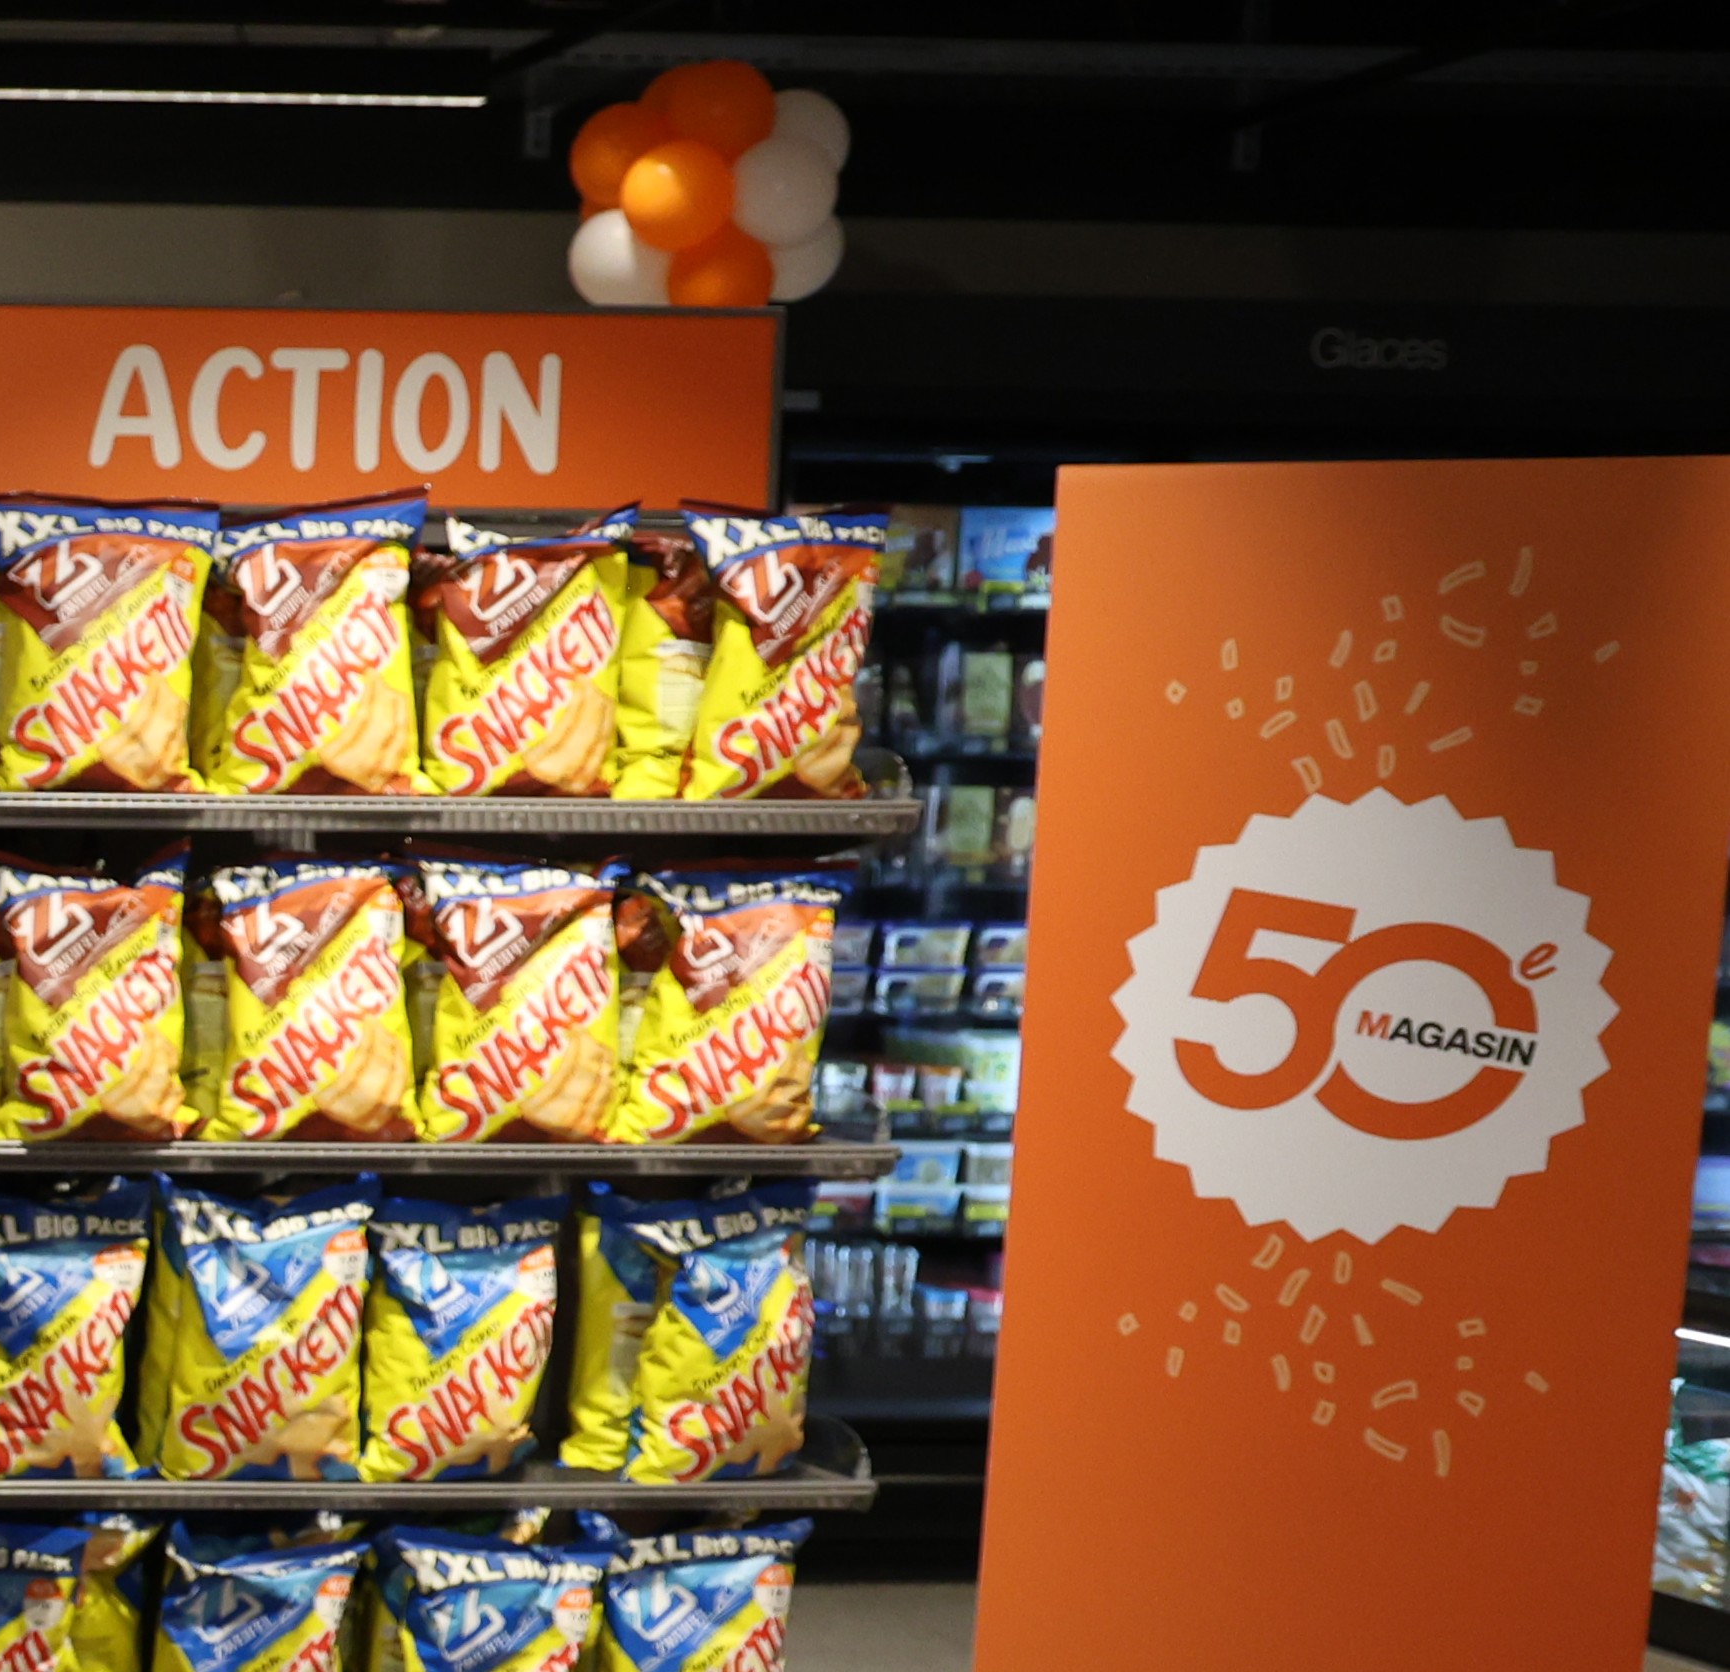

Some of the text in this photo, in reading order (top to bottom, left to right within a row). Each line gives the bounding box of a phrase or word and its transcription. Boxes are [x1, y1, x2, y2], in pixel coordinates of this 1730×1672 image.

[1310, 327, 1447, 370] Glaces
[88, 344, 562, 474] ACTION
[95, 516, 142, 536] BIG
[147, 519, 216, 548] PACK
[298, 517, 347, 539] BIG
[687, 512, 800, 570] XXL
[799, 515, 833, 542] BIG
[14, 594, 195, 789] SNACKETTI
[521, 867, 571, 892] BIG
[726, 881, 775, 903] BIG
[1356, 1010, 1537, 1067] MAGASIN
[34, 1214, 81, 1240] BIG
[84, 1216, 146, 1237] PACK
[712, 1214, 758, 1240] BIG
[693, 1535, 741, 1557] BIG
[12, 1549, 73, 1573] PACK
[402, 1549, 505, 1592] XXL
